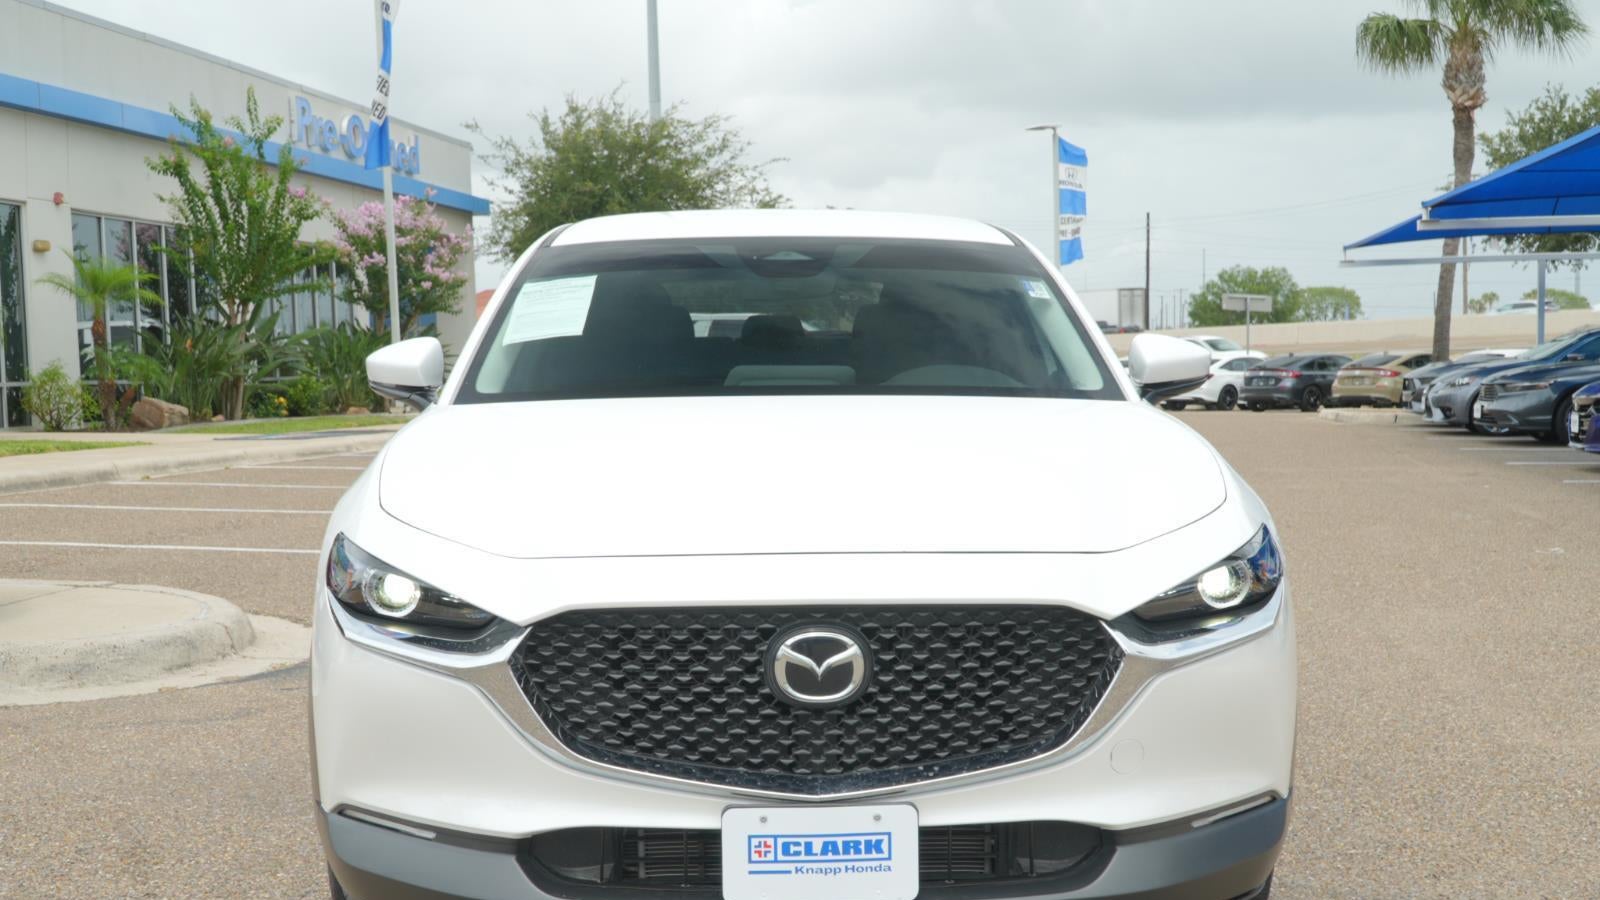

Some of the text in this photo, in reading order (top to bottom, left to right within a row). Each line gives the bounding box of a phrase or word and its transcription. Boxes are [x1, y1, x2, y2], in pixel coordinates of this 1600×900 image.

[781, 839, 884, 857] CLARK
[795, 864, 892, 876] Knapp Honda
